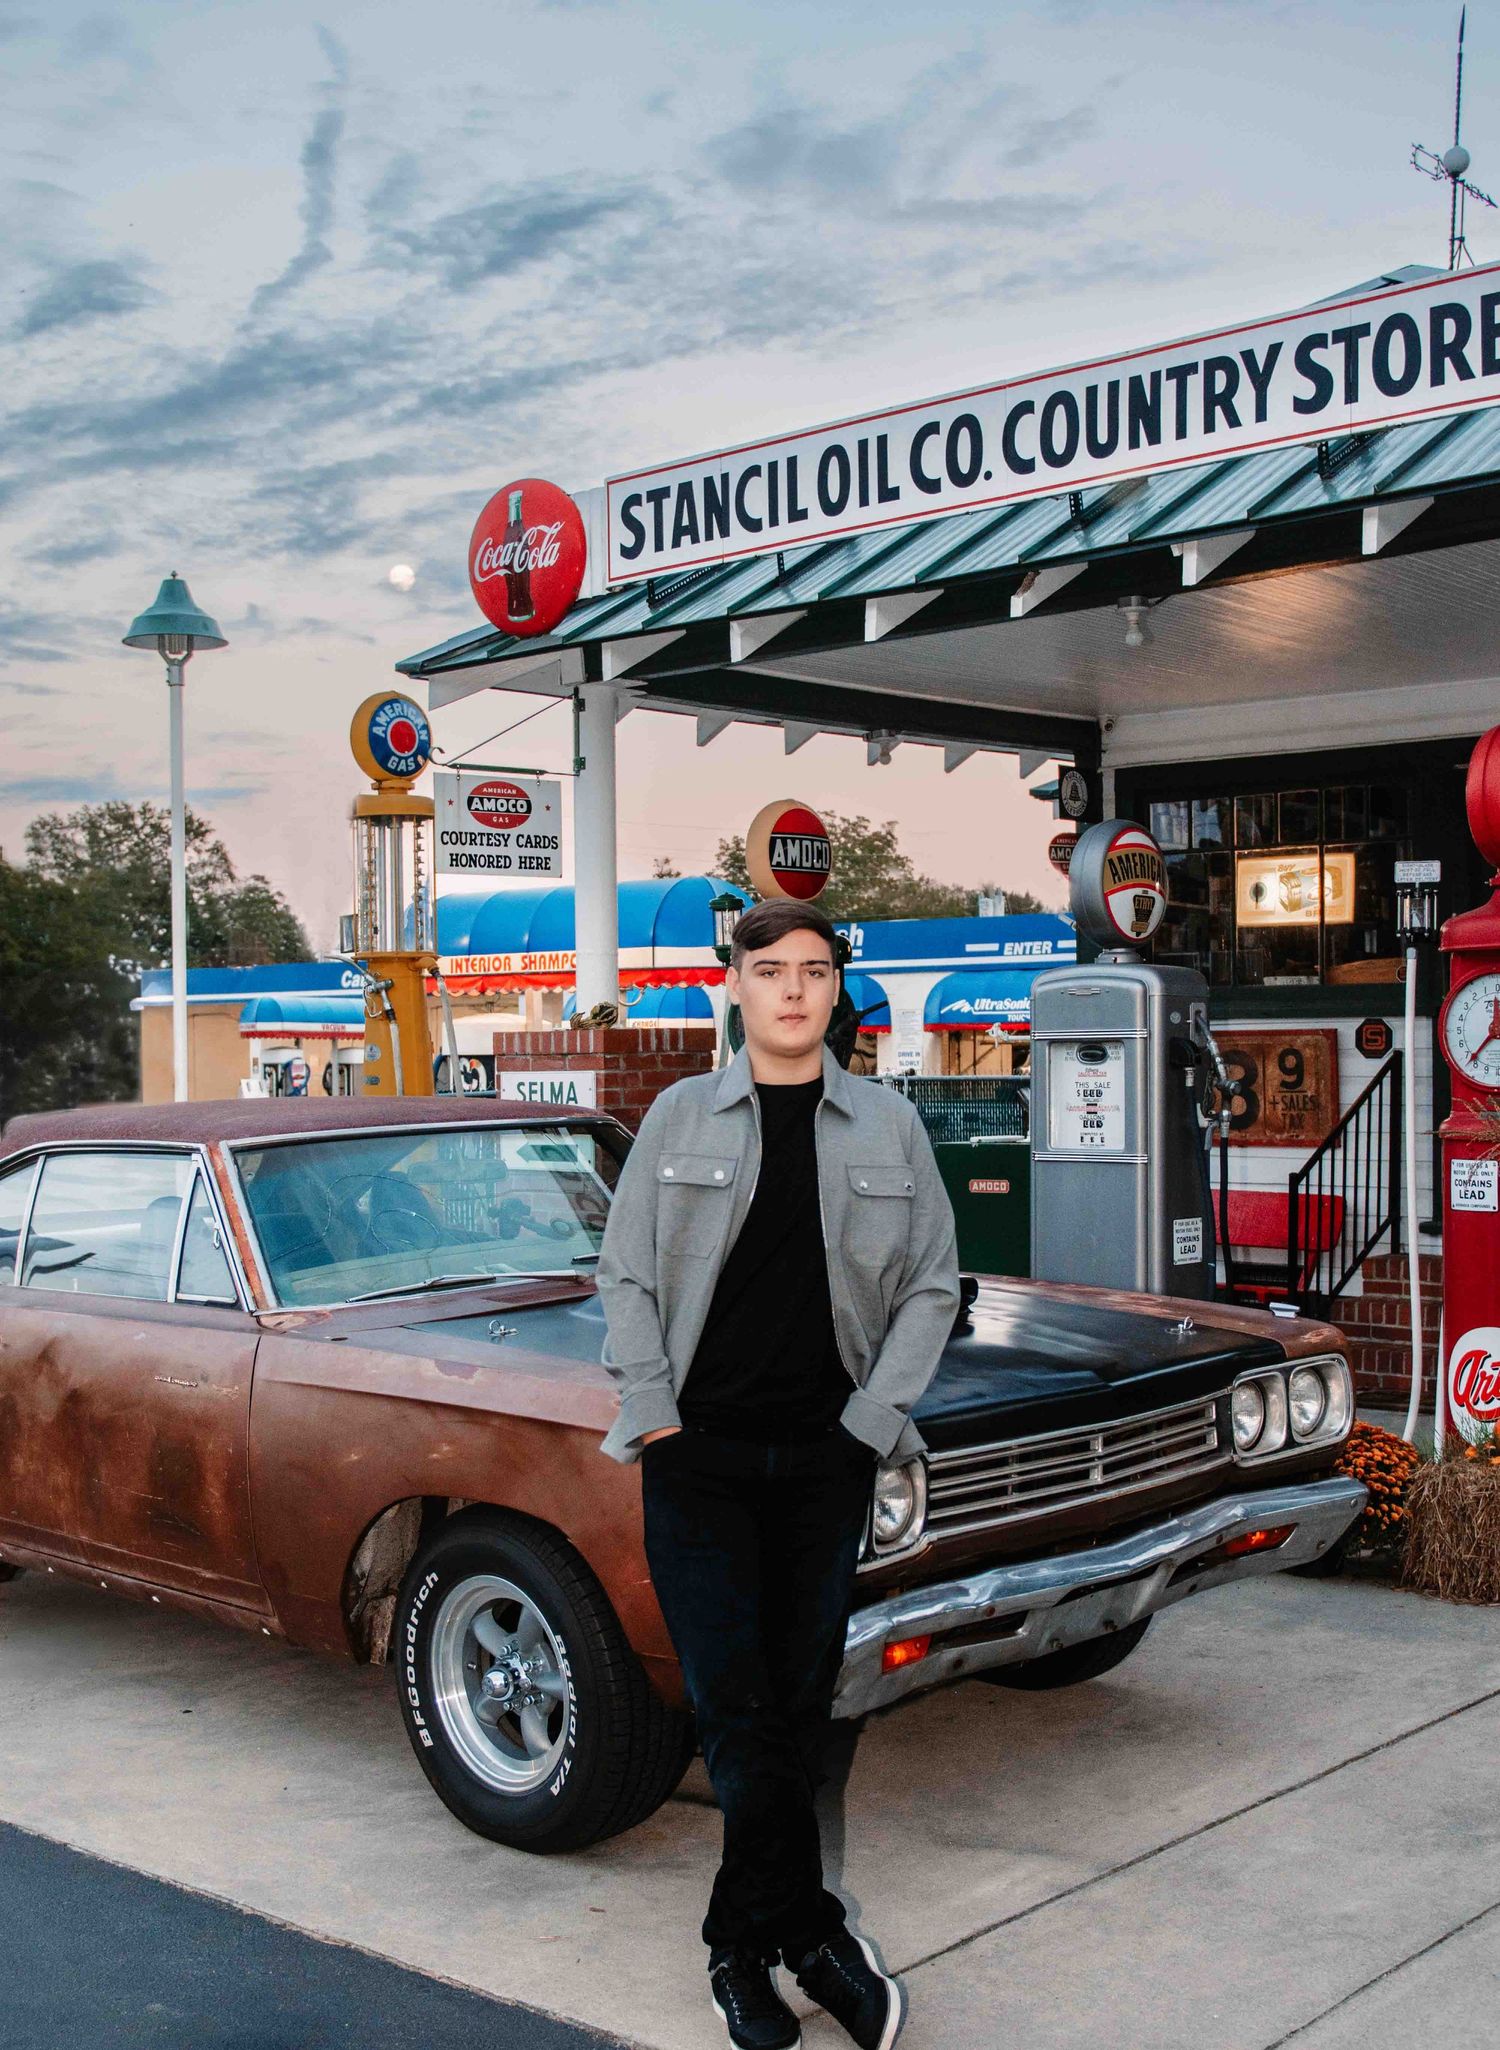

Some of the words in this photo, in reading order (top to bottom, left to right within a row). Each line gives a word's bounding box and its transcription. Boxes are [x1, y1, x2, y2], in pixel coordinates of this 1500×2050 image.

[620, 456, 808, 560] STANCIL
[818, 434, 900, 517] OIL
[910, 413, 992, 494] CO.
[1002, 341, 1284, 475] COUNTRY
[1293, 291, 1500, 415] STORE
[474, 521, 566, 582] Coca-Cola
[372, 702, 429, 741] AMERICAN
[387, 755, 415, 772] GAS
[482, 787, 517, 795] AMERICAN
[470, 798, 528, 813] AMOCO
[440, 831, 511, 847] COURTESY
[516, 833, 558, 850] CARDS
[771, 838, 829, 869] AMOCO
[449, 853, 512, 869] HONORED
[518, 856, 551, 870] HERE
[1003, 941, 1052, 956] ENTER
[450, 957, 512, 974] INTERIOR
[1463, 1002, 1469, 1010] 3
[1458, 1014, 1463, 1022] 4
[1457, 1026, 1462, 1035] 5
[1459, 1040, 1464, 1048] 6
[1278, 1048, 1304, 1089] 9
[517, 1081, 578, 1105] SELMA
[972, 1181, 1007, 1191] AMOCO
[1455, 1179, 1492, 1188] CONTAINS
[1459, 1190, 1485, 1200] LEAD
[1177, 1234, 1200, 1244] CONTAINS
[1180, 1245, 1196, 1254] LEAD
[406, 1571, 439, 1748] BFGoodrich
